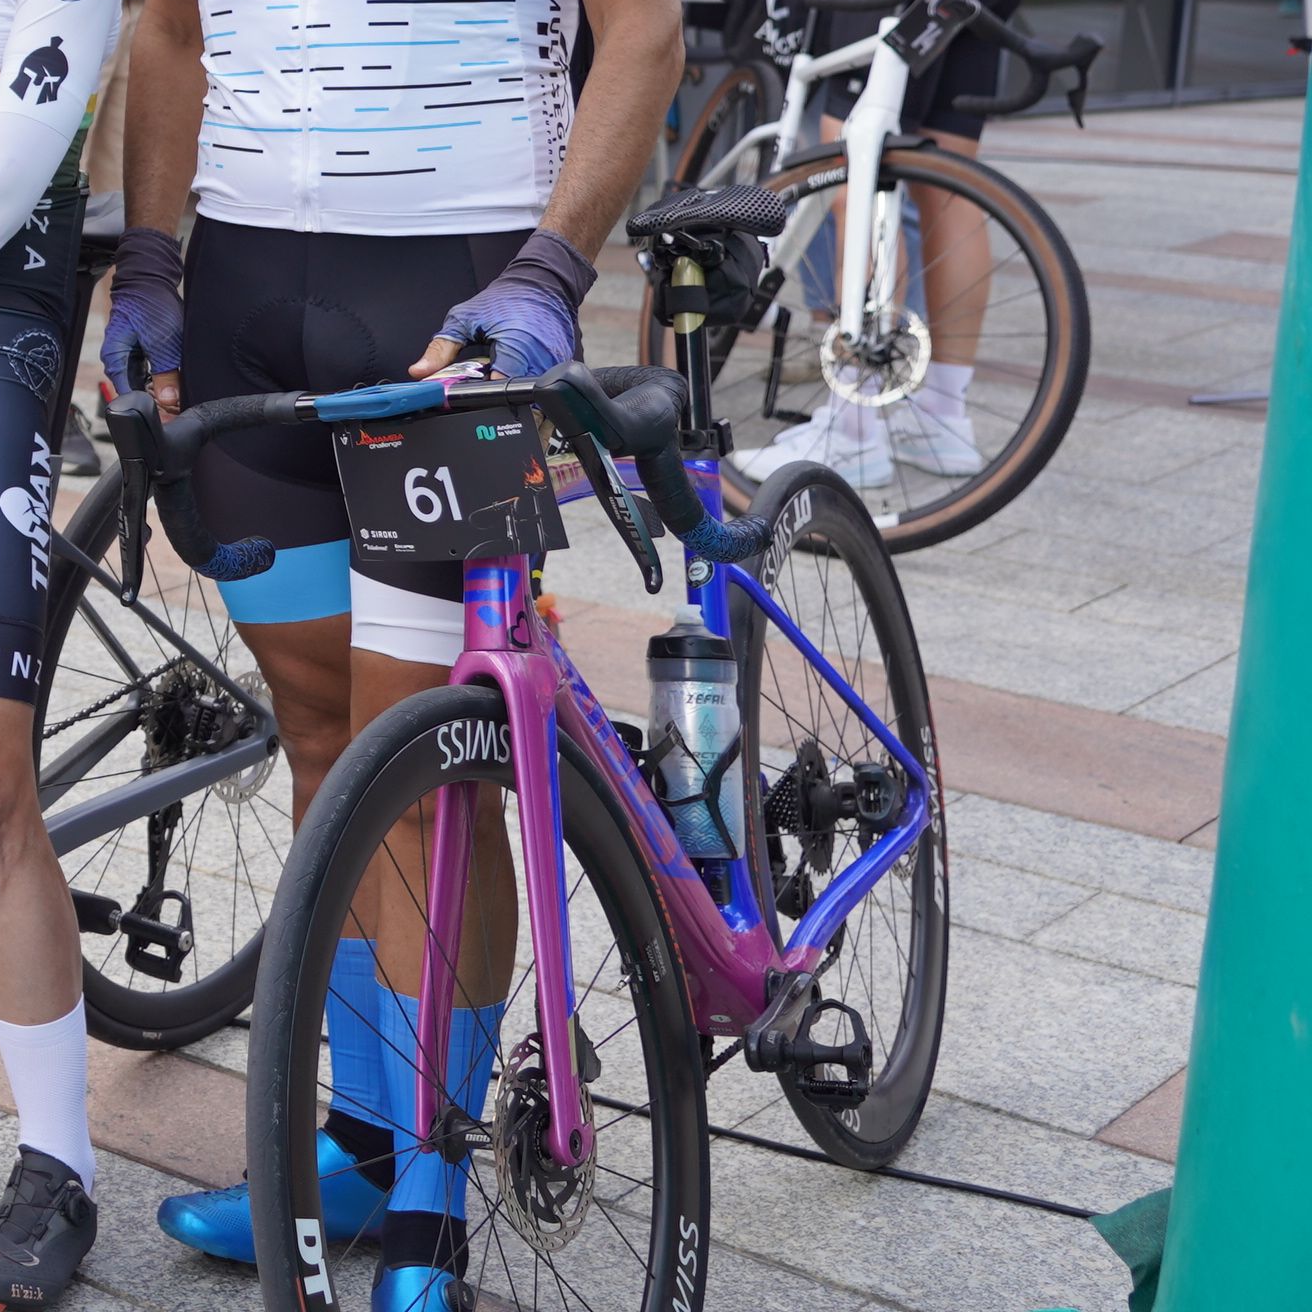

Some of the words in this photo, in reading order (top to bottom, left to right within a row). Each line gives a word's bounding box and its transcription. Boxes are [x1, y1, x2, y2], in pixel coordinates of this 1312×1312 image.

[404, 465, 463, 523] 61
[437, 721, 513, 771] SWISS
[294, 1217, 336, 1307] DT
